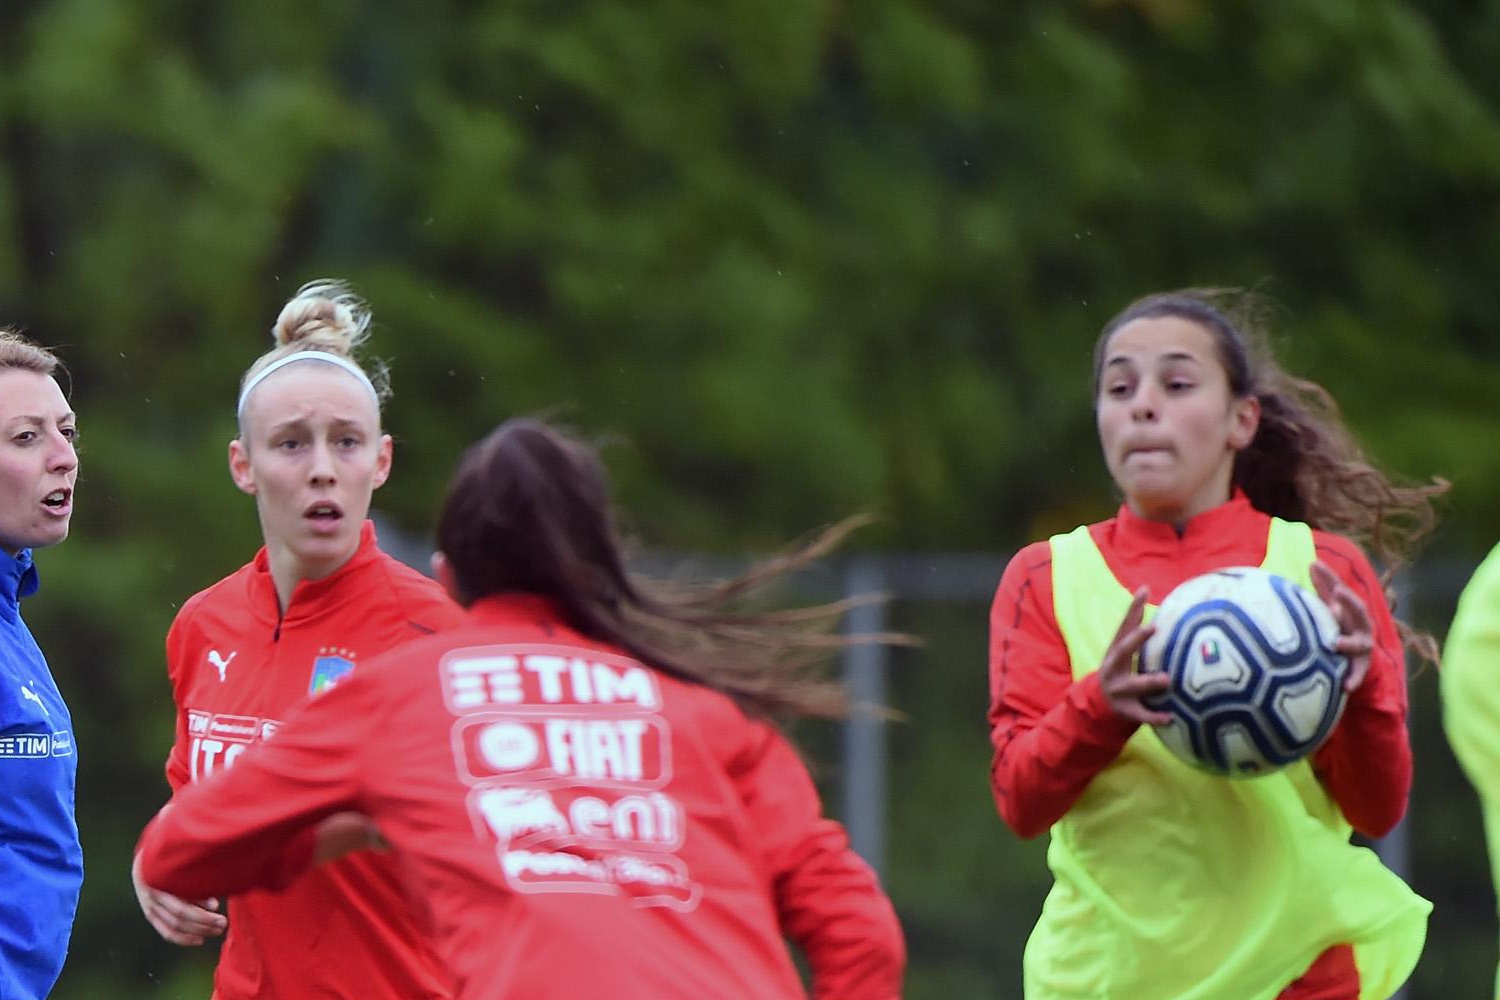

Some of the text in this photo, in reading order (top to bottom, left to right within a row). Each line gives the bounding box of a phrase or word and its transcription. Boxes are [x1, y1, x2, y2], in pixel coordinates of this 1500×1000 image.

[524, 655, 657, 708] TIM
[16, 736, 47, 754] TIM
[545, 718, 648, 780] FIAT
[568, 791, 676, 844] eni
